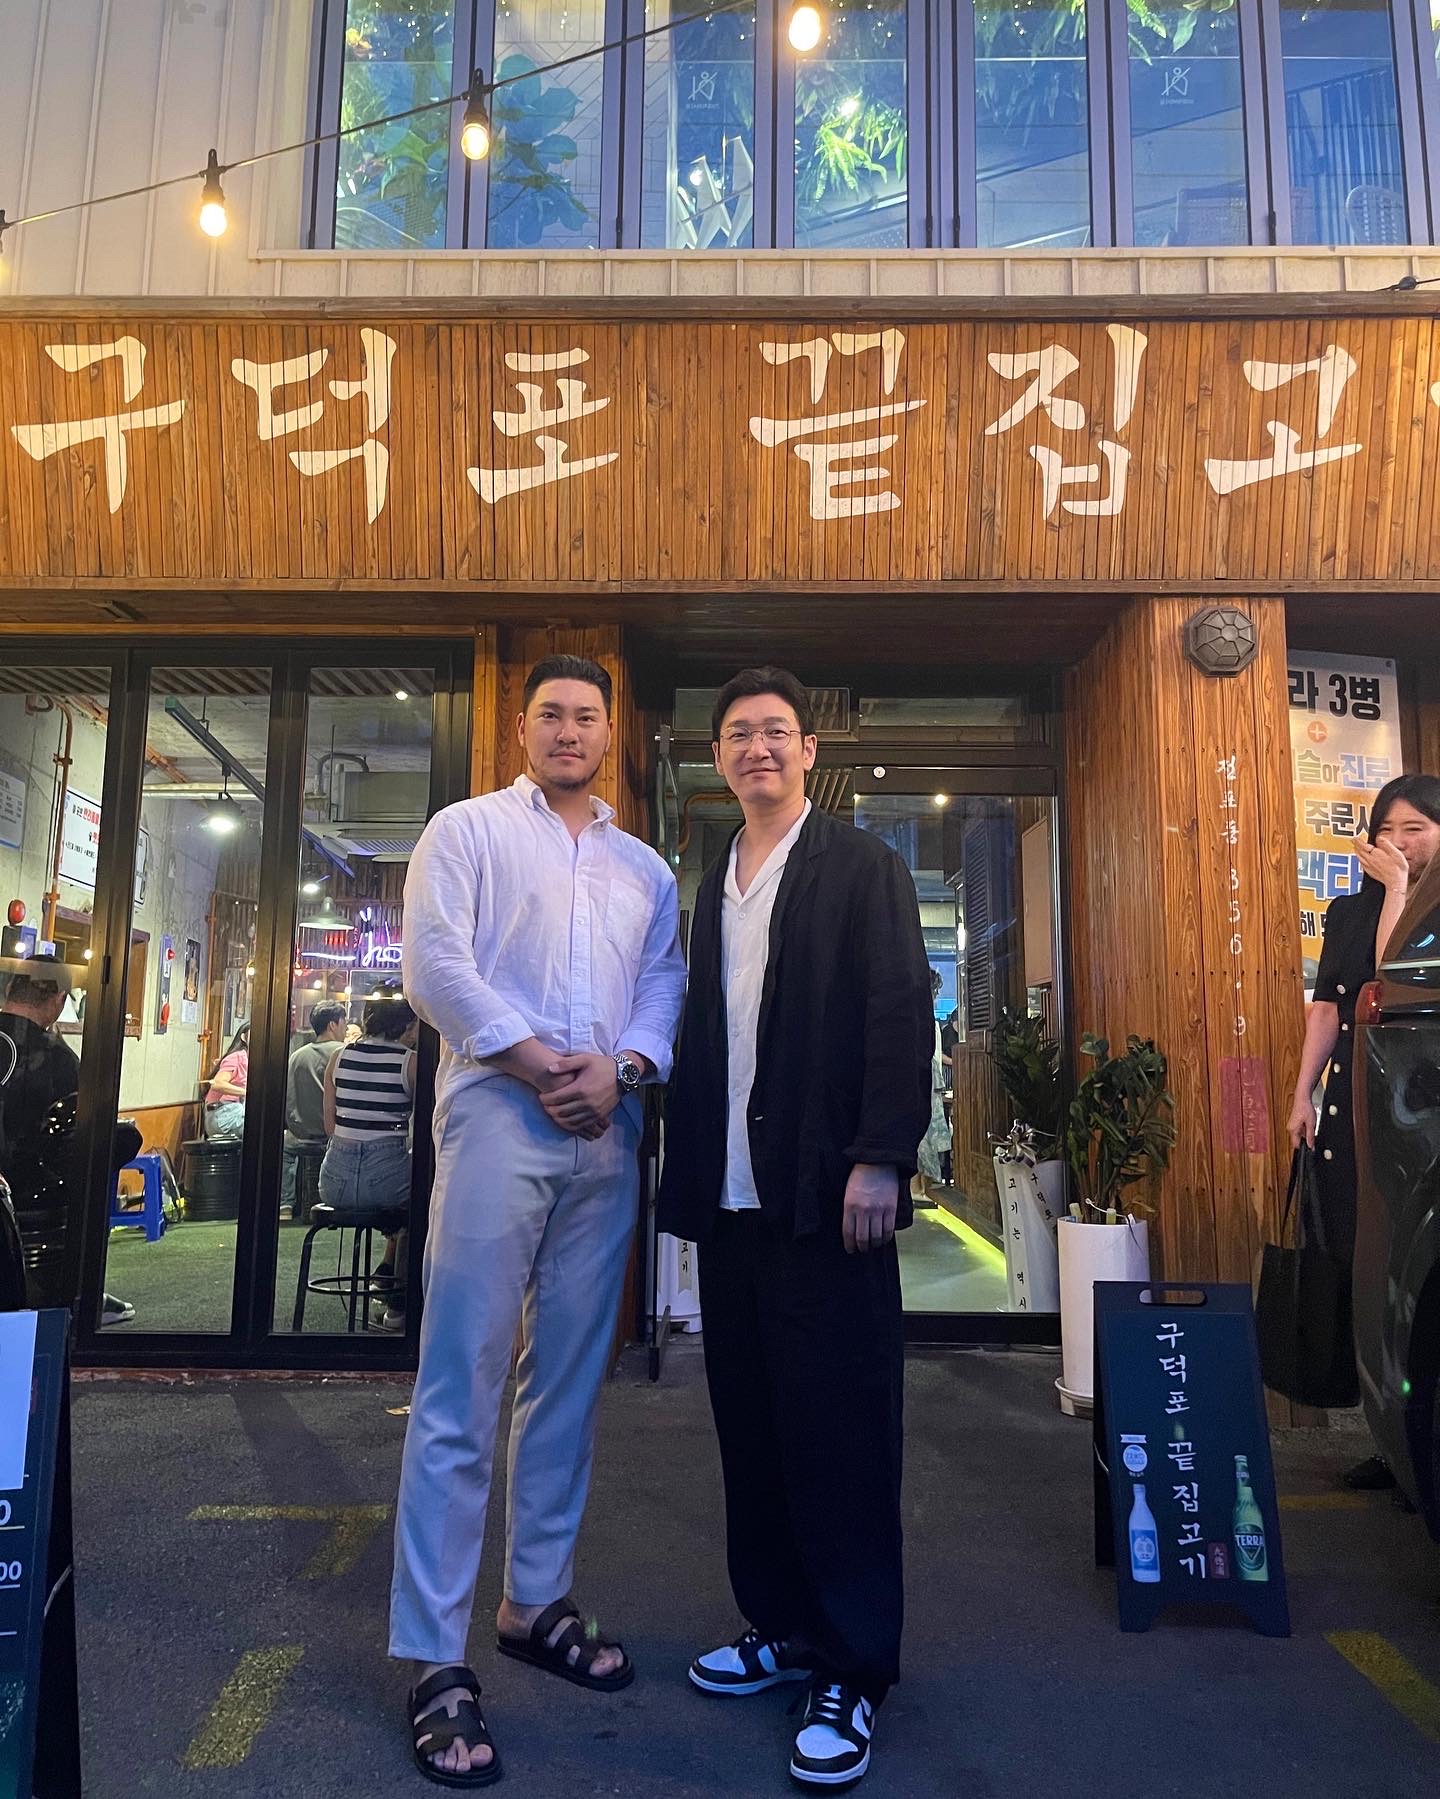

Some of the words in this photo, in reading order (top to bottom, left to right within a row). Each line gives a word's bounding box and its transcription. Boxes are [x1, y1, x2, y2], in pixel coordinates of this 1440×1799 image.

[11, 327, 619, 524] 구덕포
[749, 324, 1440, 521] 끝집고
[1328, 673, 1380, 720] 3병
[1156, 1323, 1191, 1414] 구덕포
[1234, 1534, 1264, 1546] TERRA
